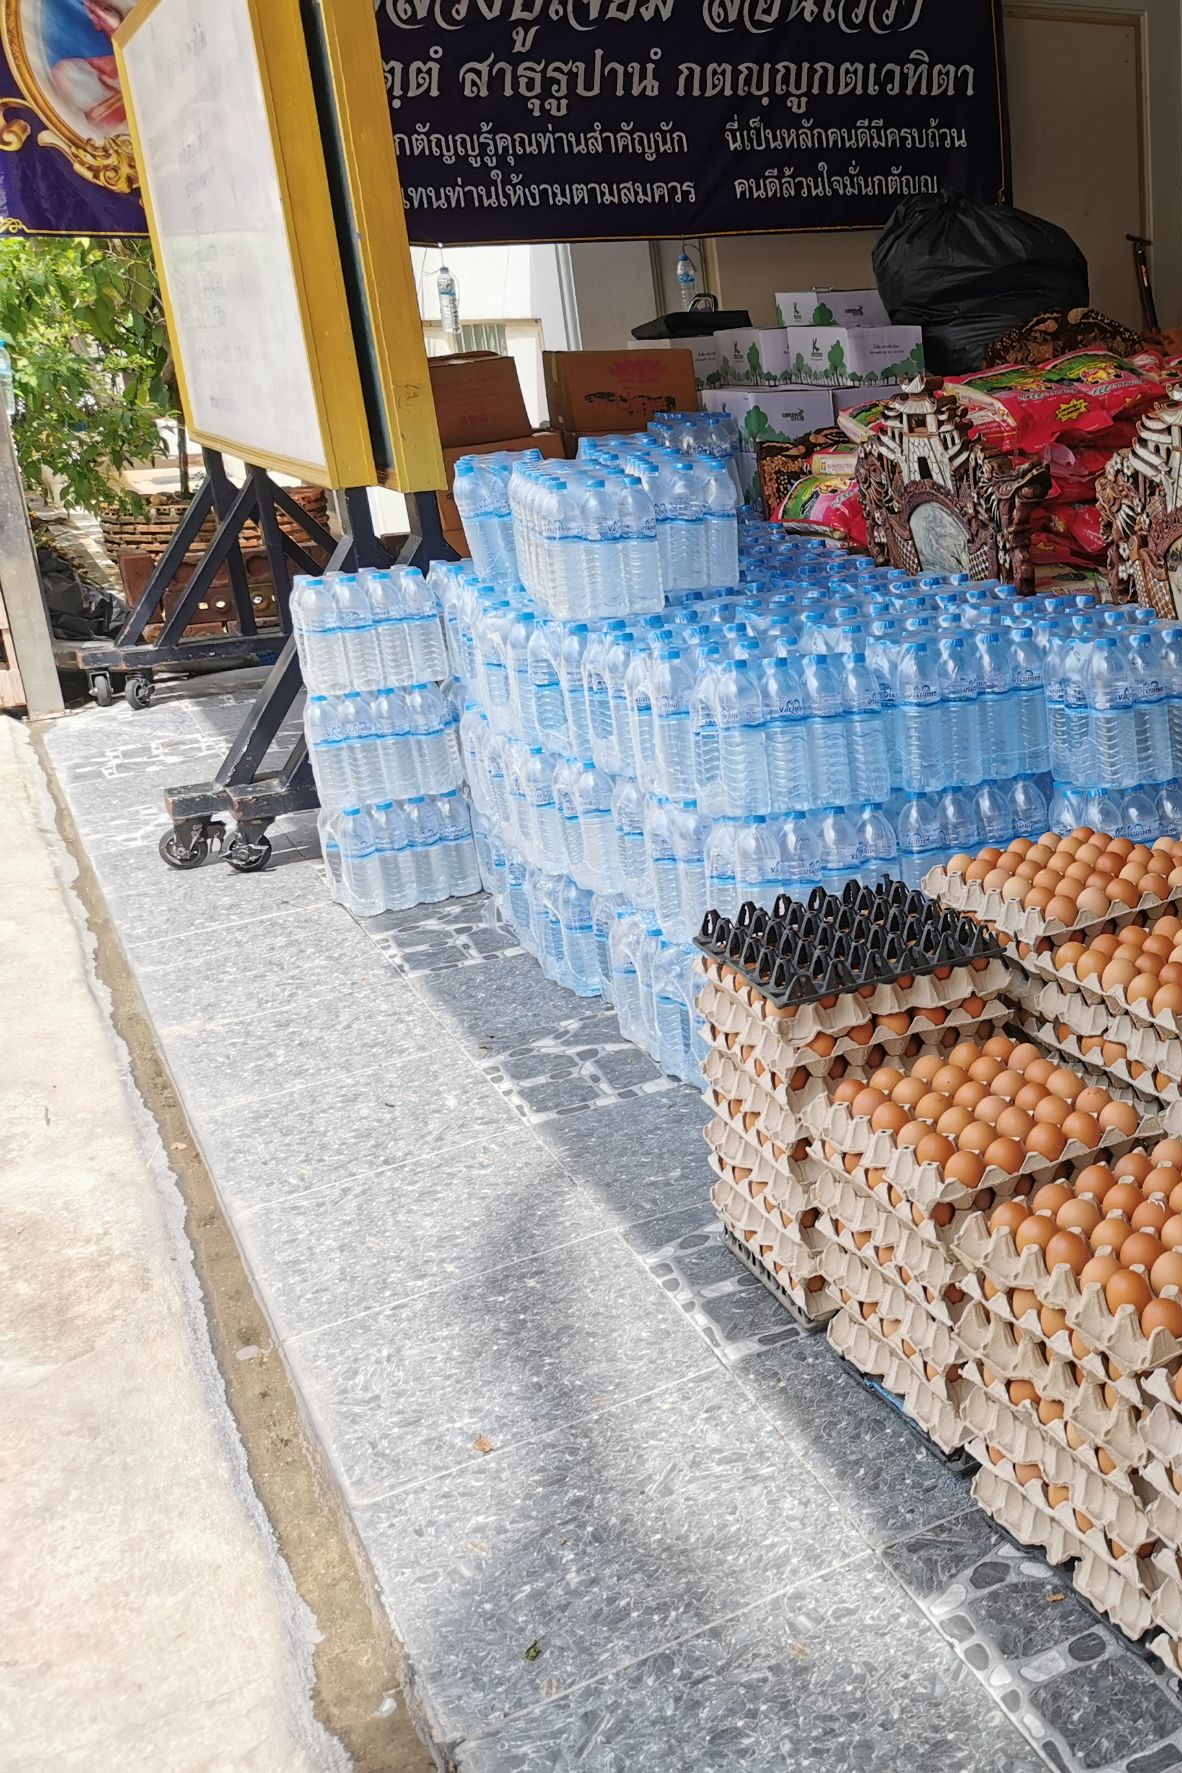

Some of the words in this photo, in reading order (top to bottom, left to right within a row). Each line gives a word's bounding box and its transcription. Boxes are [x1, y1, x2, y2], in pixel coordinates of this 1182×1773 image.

[724, 114, 967, 151] นี่เป็นหลักคนดีมีครบถ้วน
